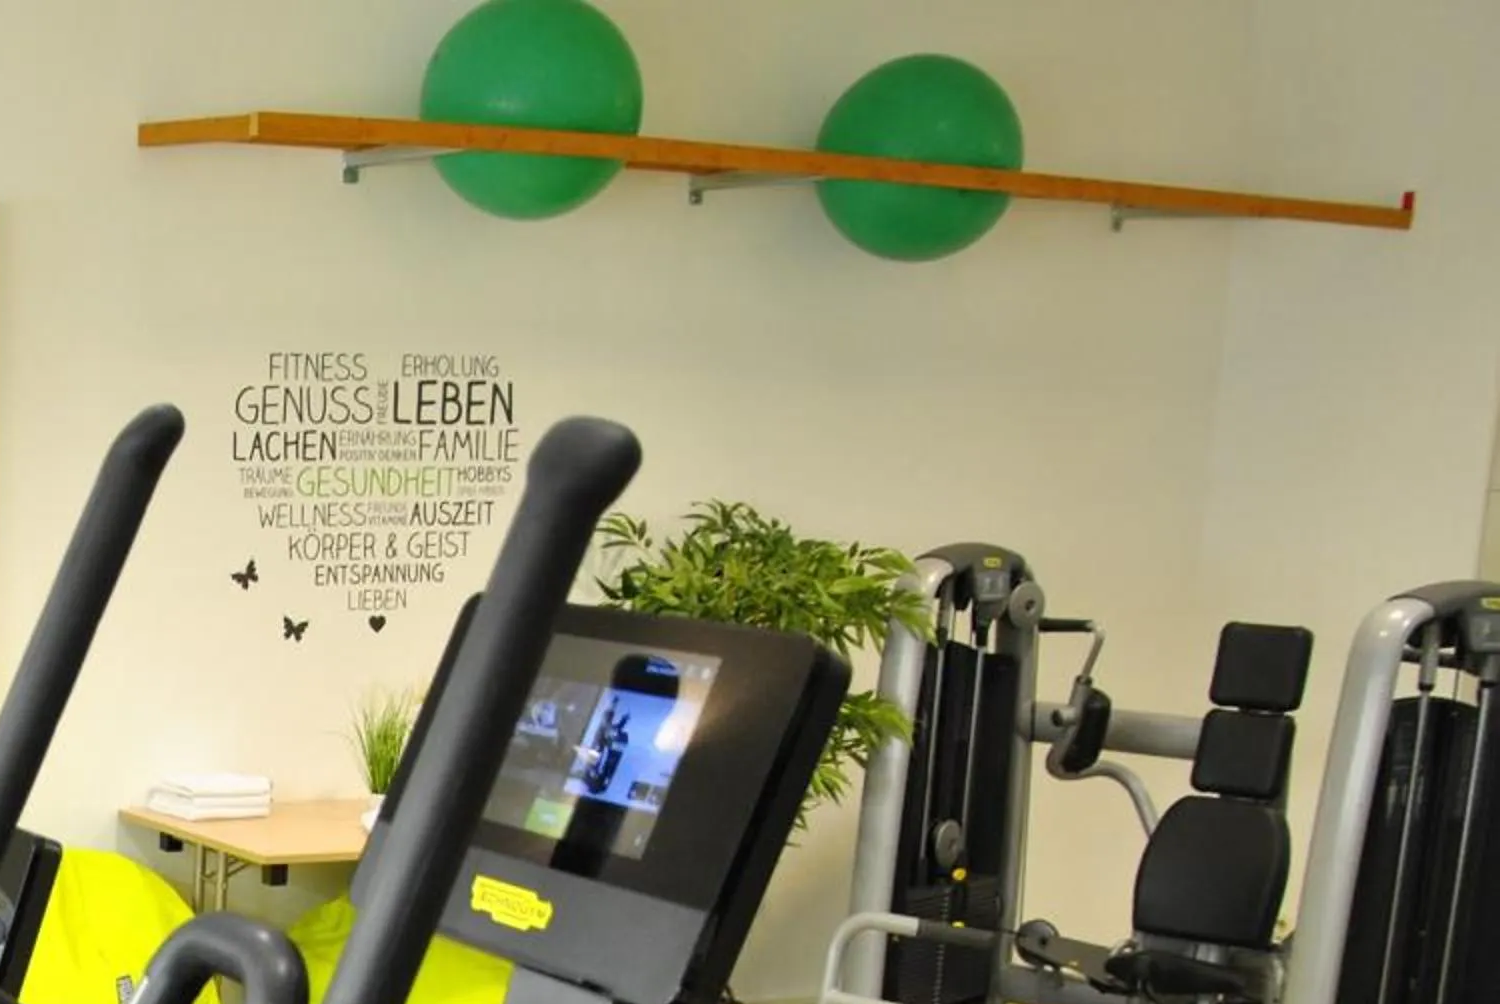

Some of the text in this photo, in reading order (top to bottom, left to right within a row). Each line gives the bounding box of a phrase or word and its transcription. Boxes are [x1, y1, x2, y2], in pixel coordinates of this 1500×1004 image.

[269, 352, 367, 381] FITNESS
[402, 353, 499, 378] ERHOLUNG
[235, 385, 373, 425] GENUSS
[393, 380, 513, 425] LEBEN
[233, 430, 337, 462] LACHEN
[419, 429, 519, 462] FAMILIE
[296, 466, 458, 498] GESUNDHEIT
[457, 465, 512, 482] HOBBYS
[258, 502, 367, 528] WELLNESS
[409, 501, 495, 527] AUSZEIT
[288, 528, 470, 561] KÖRPER & GEIST
[314, 563, 444, 586] ENTSPANNUNG
[348, 589, 407, 611] LIEBEN
